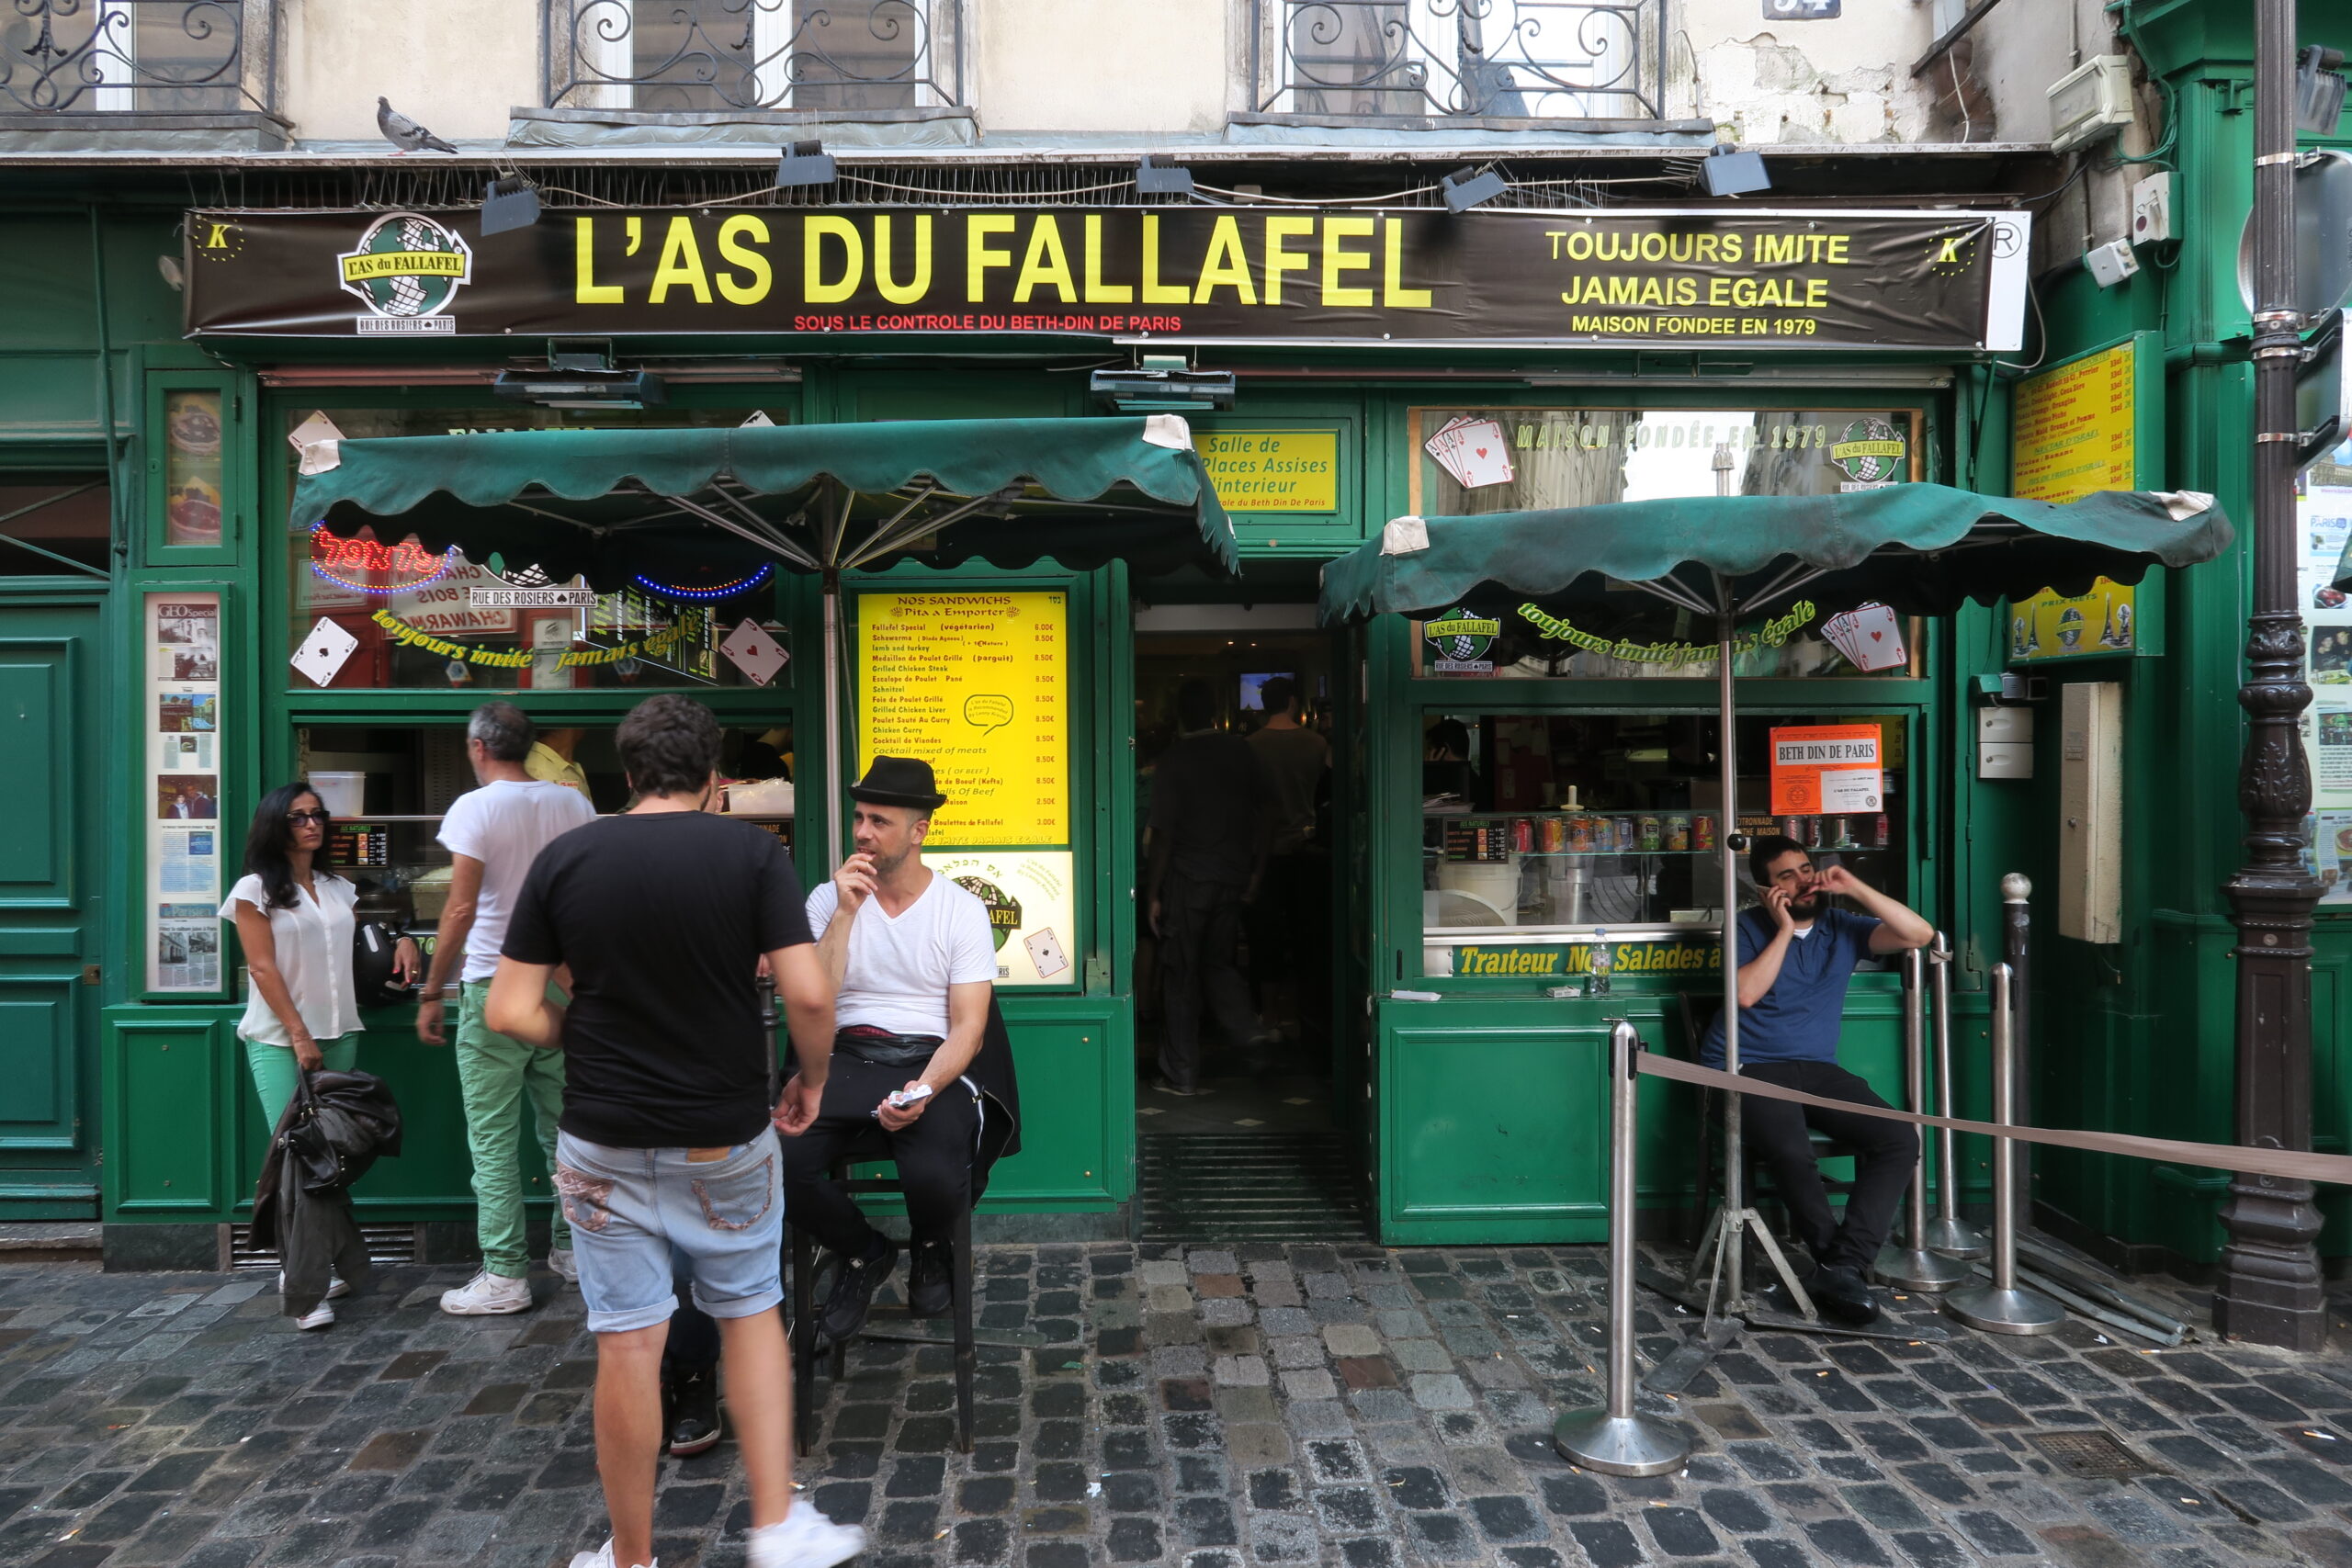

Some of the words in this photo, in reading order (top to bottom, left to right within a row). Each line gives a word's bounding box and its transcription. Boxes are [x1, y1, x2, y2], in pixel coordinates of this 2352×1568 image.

[208, 223, 228, 249] K
[1545, 231, 1743, 265] TOUJOURS
[1754, 233, 1850, 265] IMITE
[1938, 238, 1961, 264] K
[348, 259, 373, 276] L'AS
[378, 258, 391, 270] du
[393, 256, 461, 272] FALLAFEL
[574, 215, 772, 305] L'AS
[804, 215, 933, 305] DU
[967, 215, 1432, 308] FALLAFEL
[1562, 276, 1698, 307] JAMAIS
[1709, 278, 1828, 309] EGALE
[360, 320, 374, 331] RUE
[375, 320, 390, 331] DES
[391, 320, 423, 331] ROSIERS
[434, 320, 455, 331] PARIS
[794, 315, 844, 331] SOUS
[849, 315, 872, 331] LE
[876, 315, 974, 331] CONTROLE
[979, 315, 1006, 331] DU
[1011, 315, 1094, 331] BETH-DIN
[1099, 315, 1124, 331] DE
[1129, 315, 1182, 332] PARIS
[1571, 316, 1650, 334] MAISON
[1656, 317, 1736, 335] FONDEE
[1740, 318, 1768, 335] EN
[1773, 319, 1816, 336] 1979
[1516, 424, 1609, 449] MAISON
[1623, 422, 1714, 449] FONDÉE
[1728, 425, 1757, 449] EN
[1770, 424, 1826, 449] 1979
[1208, 437, 1252, 453] Salle
[1259, 436, 1281, 453] de
[1834, 445, 1851, 458] L'AS
[1852, 444, 1860, 454] du
[1862, 442, 1902, 455] FALLAFEL
[1203, 458, 1256, 473] Places
[1262, 458, 1328, 473] Assises
[1213, 478, 1296, 493] 'interieur
[472, 592, 491, 605] RUE
[492, 592, 512, 604] DES
[514, 592, 555, 604] ROSIERS
[569, 592, 597, 604] PARIS
[898, 596, 925, 605] NOS
[929, 596, 1012, 605] SANDWICHS
[159, 604, 188, 617] GEO
[188, 607, 217, 618] Special
[904, 607, 930, 616] Pita
[944, 607, 1005, 618] Emporter
[900, 624, 926, 632] Special
[1429, 624, 1445, 637] L'AS
[1446, 622, 1455, 632] du
[1456, 621, 1497, 634] FALLAFEL
[1517, 602, 1611, 654] toujours
[1611, 638, 1678, 664] imité
[1677, 632, 1758, 670] jamis
[1761, 600, 1816, 649] égalé
[370, 608, 467, 660] toujours
[469, 644, 534, 669] imité
[549, 638, 639, 674] jamais
[907, 645, 930, 653] turkey
[973, 655, 1013, 663] (parguit)
[931, 716, 951, 725] Curry
[902, 727, 922, 735] Curry
[944, 747, 956, 755] of
[1779, 746, 1804, 761] BETH
[1807, 745, 1826, 760] DIN
[1829, 745, 1842, 759] DE
[1845, 743, 1874, 758] PARIS
[978, 778, 1003, 786] (Kefta)
[958, 788, 970, 796] Of
[973, 788, 995, 796] Beef
[1758, 827, 1781, 836] MAISON
[939, 836, 969, 844] IMITE
[971, 836, 1012, 844] JAMAIS
[1016, 835, 1053, 843] EGALE
[989, 909, 1018, 925] AFEL
[1461, 946, 1557, 974] Traiteur
[1566, 945, 1592, 973] No
[1613, 942, 1706, 972] Salades
[1709, 942, 1722, 969] à
[999, 967, 1010, 976] RIS
